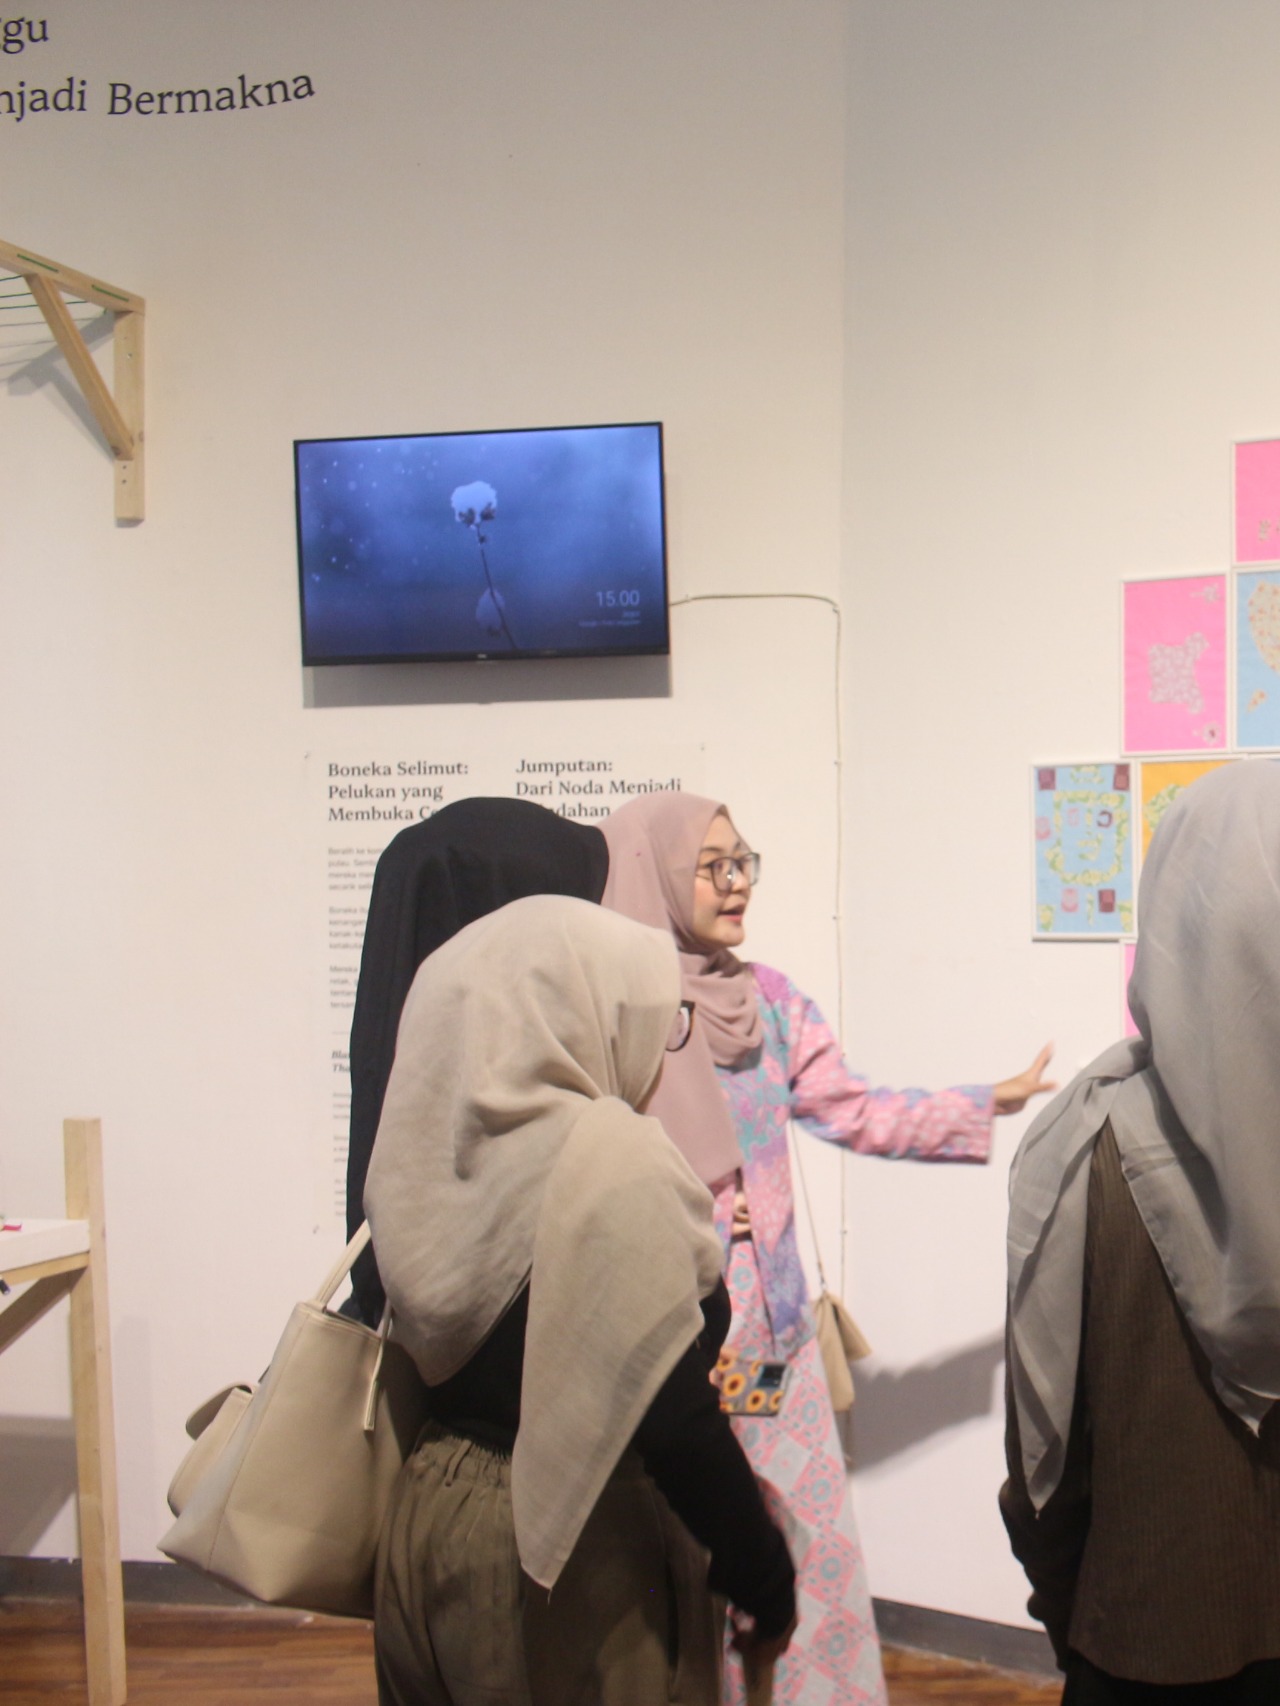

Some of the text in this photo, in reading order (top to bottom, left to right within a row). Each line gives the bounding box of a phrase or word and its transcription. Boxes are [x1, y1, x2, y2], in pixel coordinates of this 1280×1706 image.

[0, 17, 50, 54] gu
[107, 73, 316, 116] Bermakna
[328, 760, 469, 777] Boneka Selimut:
[515, 758, 613, 776] Jumputan:
[328, 783, 444, 801] Pelukan yang
[516, 780, 554, 796] Dari
[558, 779, 604, 795] Noda
[328, 806, 414, 822] Membuka
